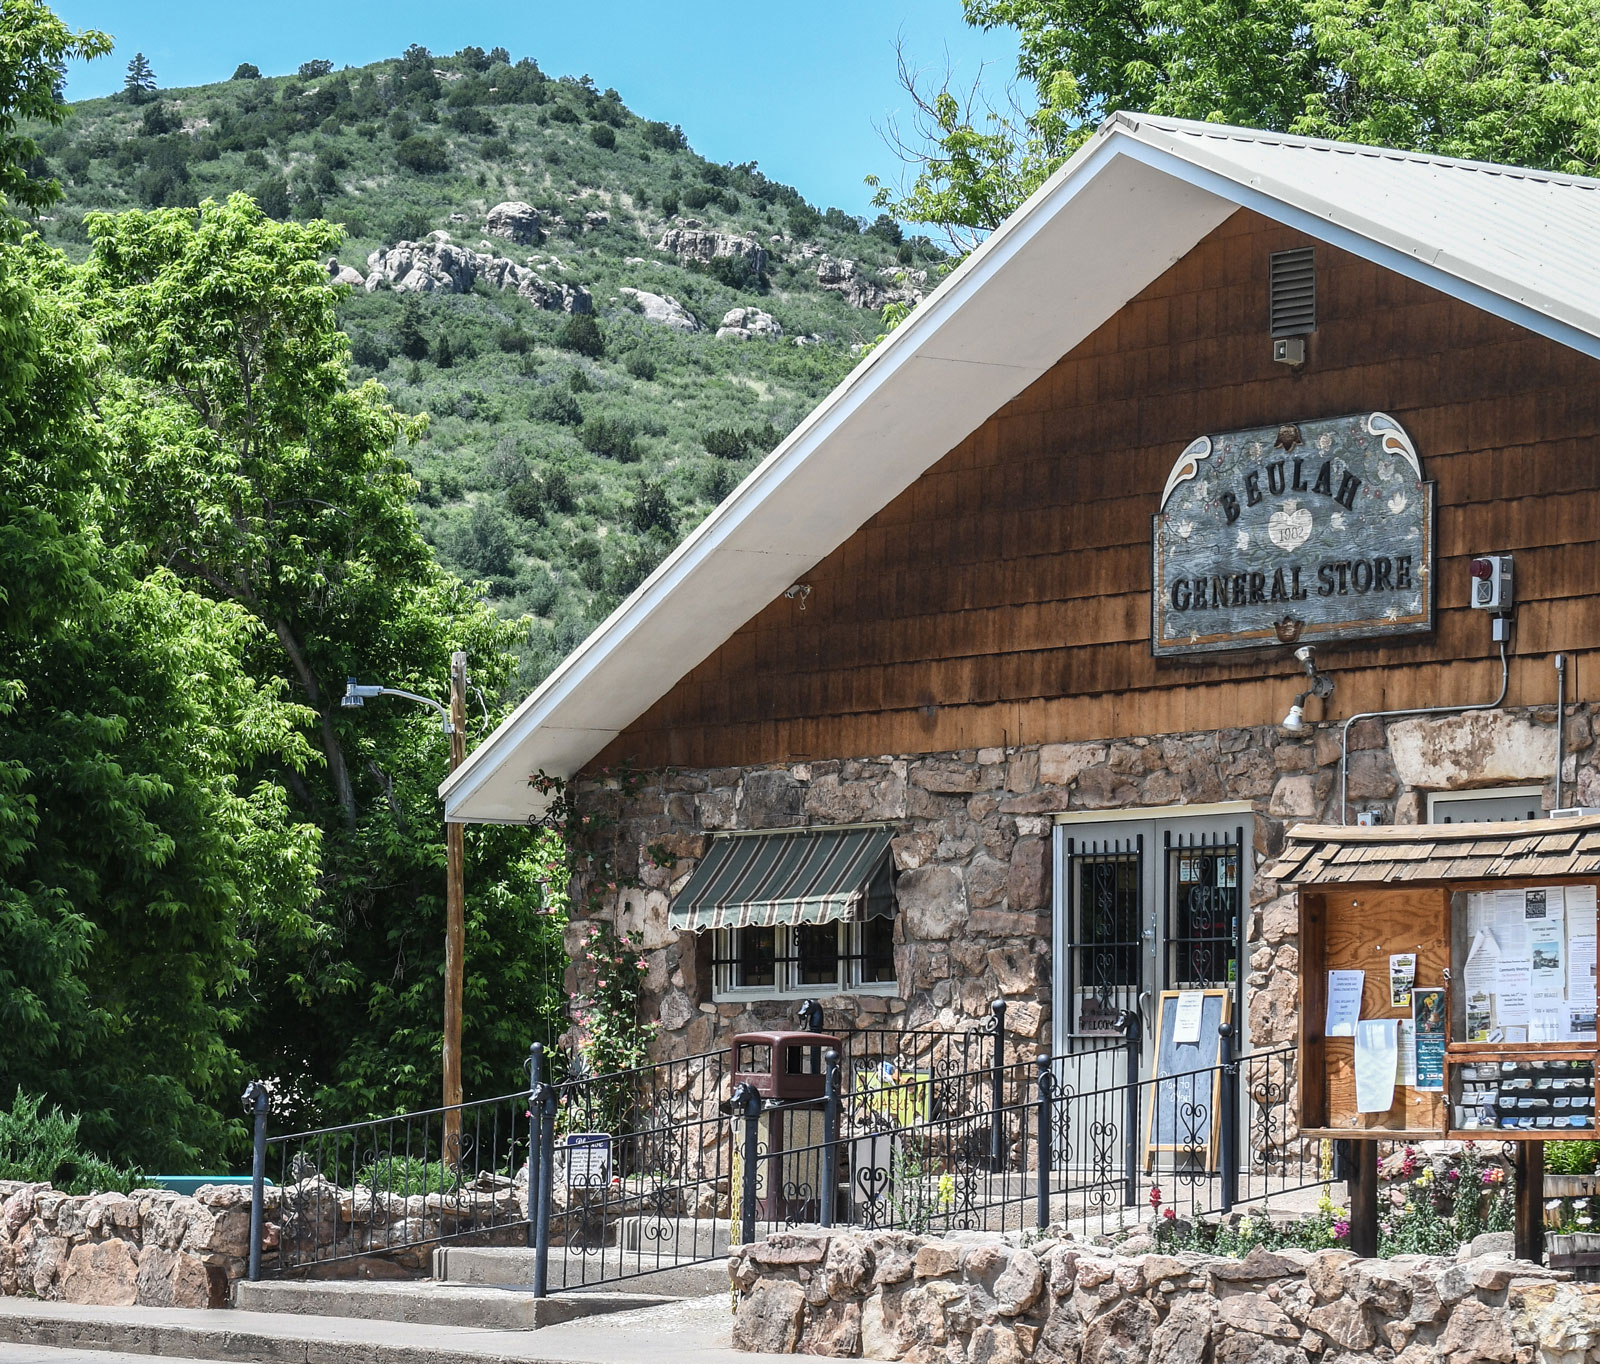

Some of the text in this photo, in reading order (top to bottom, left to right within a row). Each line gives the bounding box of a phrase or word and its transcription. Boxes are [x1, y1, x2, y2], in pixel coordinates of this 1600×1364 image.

[1220, 458, 1362, 525] BEULAH
[1171, 555, 1412, 612] GENERAL STORE
[1189, 886, 1230, 912] OPEN
[1079, 1020, 1115, 1030] WELCOM
